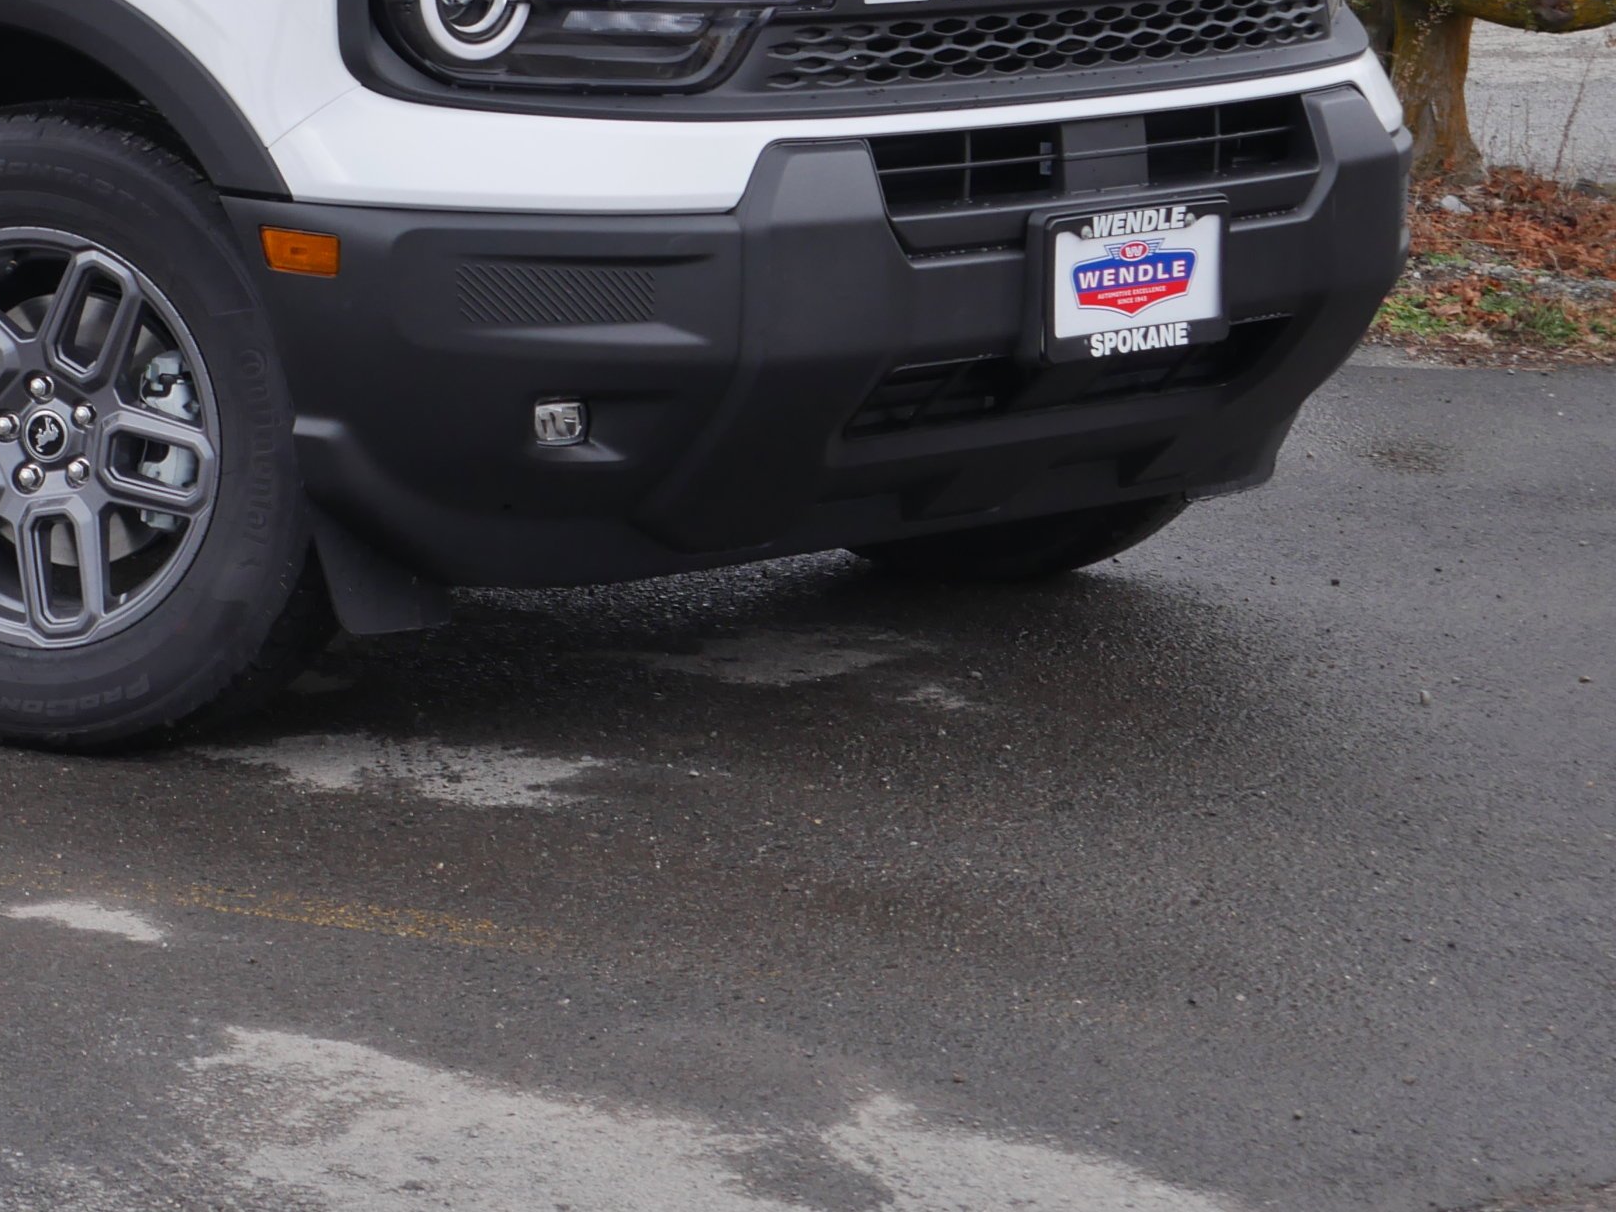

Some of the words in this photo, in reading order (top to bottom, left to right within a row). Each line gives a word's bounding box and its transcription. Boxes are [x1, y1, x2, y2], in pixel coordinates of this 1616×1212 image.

[1092, 206, 1187, 239] WENDLE
[1125, 245, 1143, 258] W
[1078, 260, 1187, 289] WENDLE
[1090, 322, 1189, 358] SPOKANE
